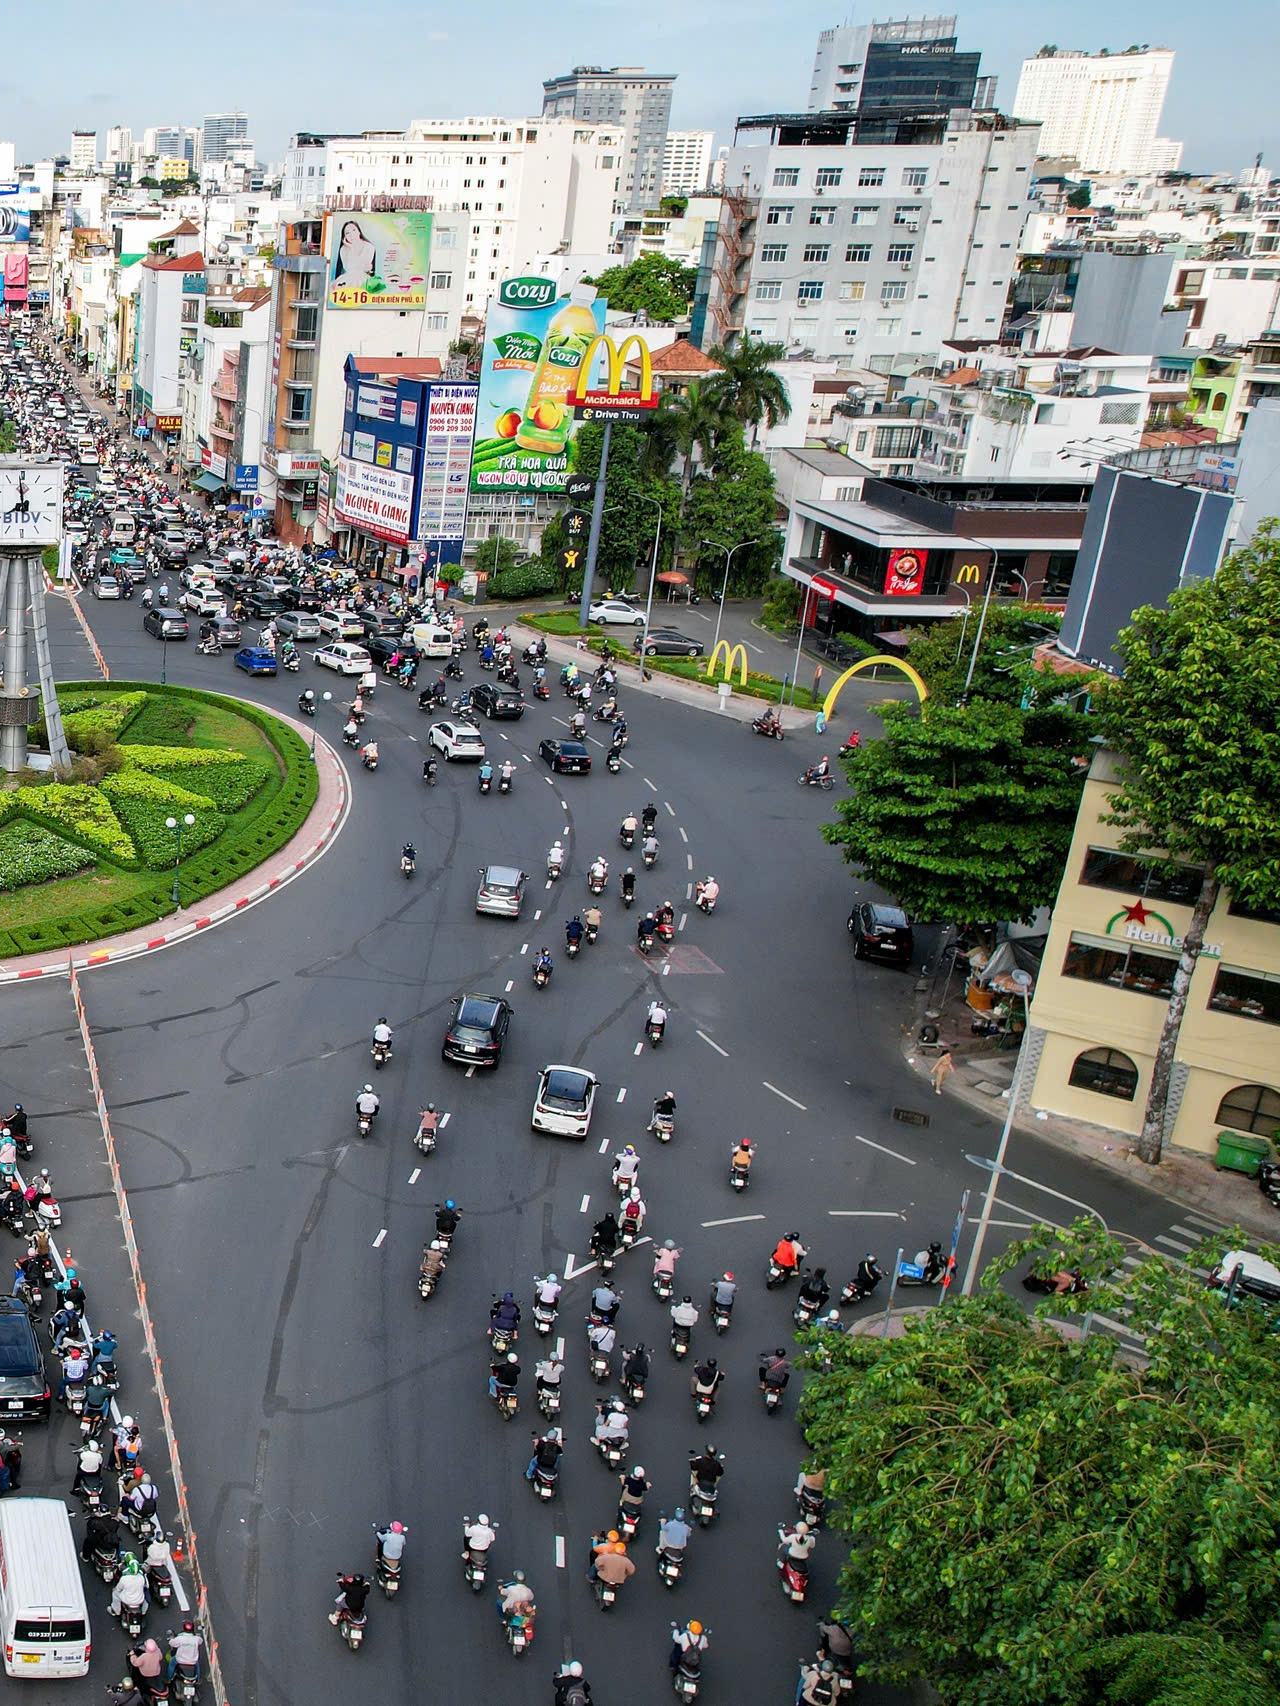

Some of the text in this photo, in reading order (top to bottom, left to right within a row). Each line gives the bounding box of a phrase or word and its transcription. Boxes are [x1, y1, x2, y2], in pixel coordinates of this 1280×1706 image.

[901, 46, 955, 54] HMC TOWER
[332, 291, 368, 304] 14-16
[505, 281, 551, 303] Cozy
[550, 349, 580, 366] Cozy
[584, 396, 641, 405] McDonald's
[456, 402, 474, 415] GIANG
[595, 410, 640, 420] Drive Thru
[498, 453, 568, 470] TRÀ HOA QUẢ
[478, 472, 501, 484] NGON
[3, 511, 41, 524] BIDV
[381, 504, 408, 524] GIANG
[1126, 922, 1221, 955] Heineen
